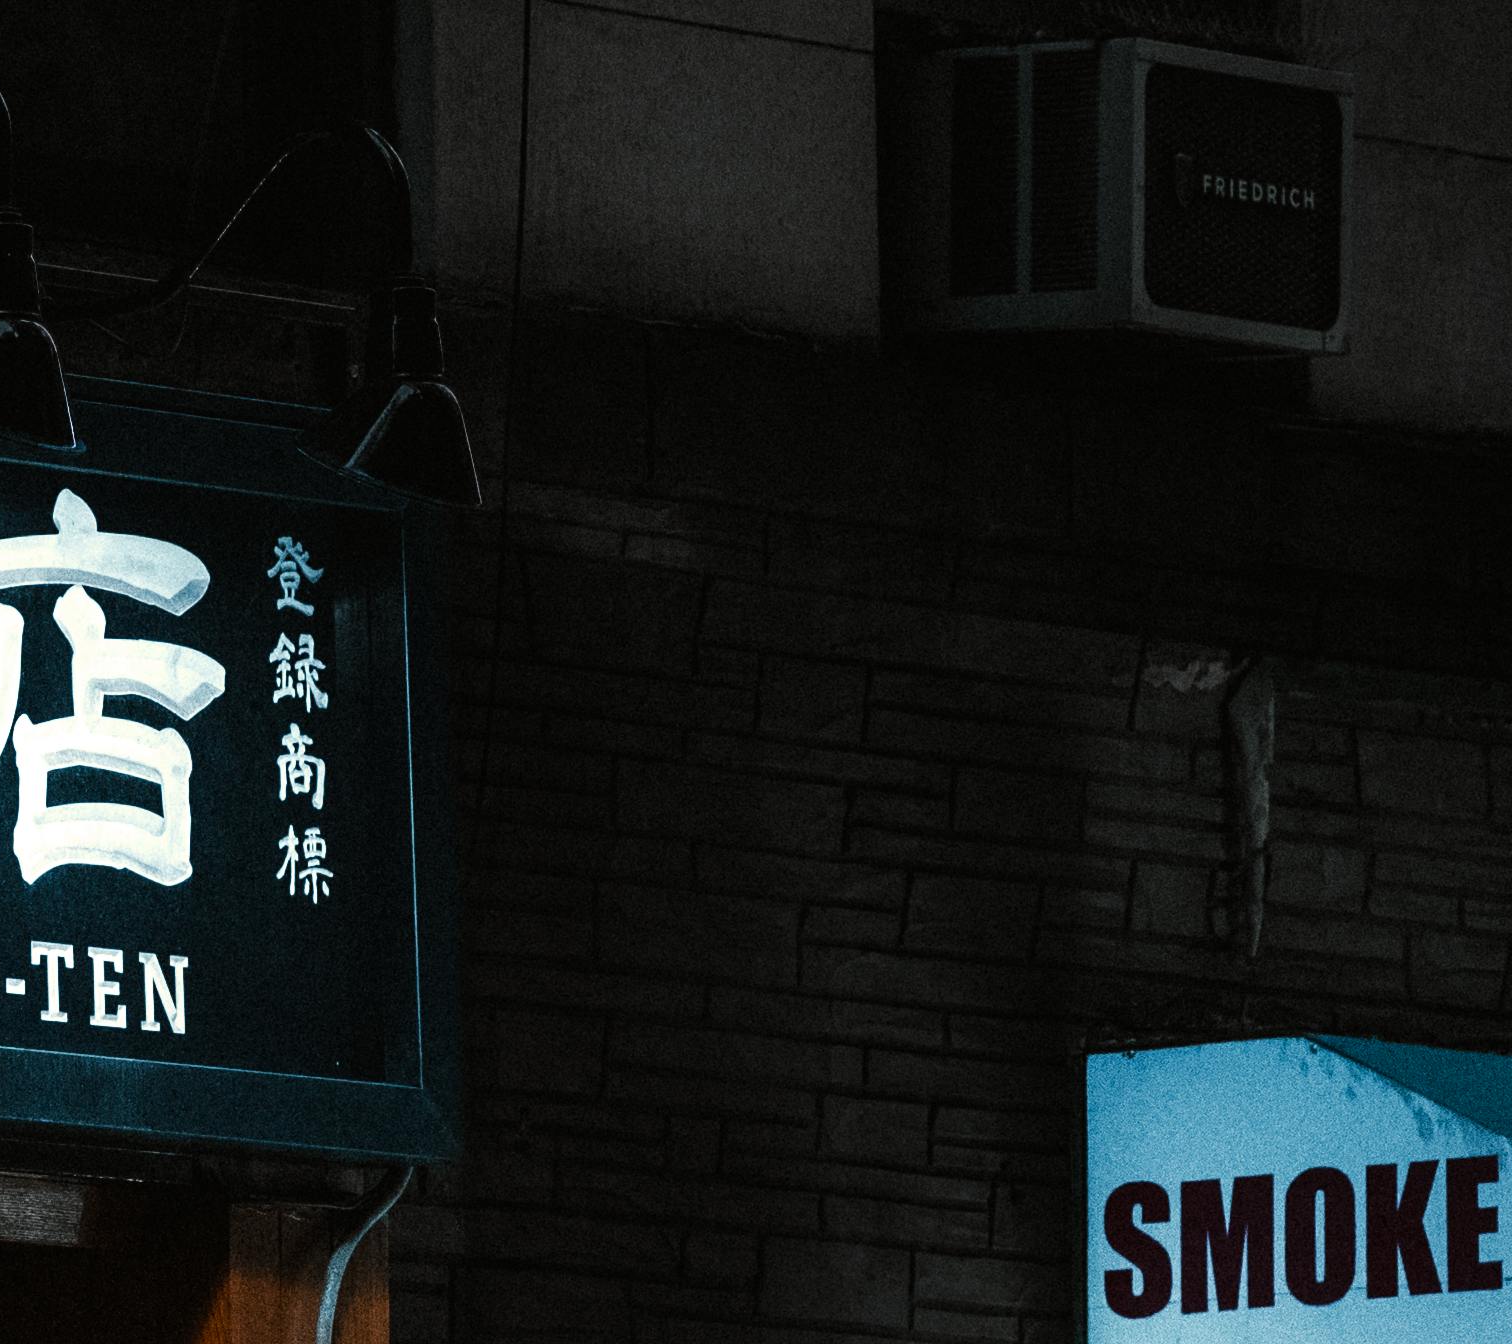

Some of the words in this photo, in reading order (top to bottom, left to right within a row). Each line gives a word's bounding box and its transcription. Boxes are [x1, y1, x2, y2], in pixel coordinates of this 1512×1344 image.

[1203, 174, 1317, 210] FRIEDRICH
[267, 535, 334, 906] 登録商標
[1102, 1155, 1504, 1320] SMOKE
